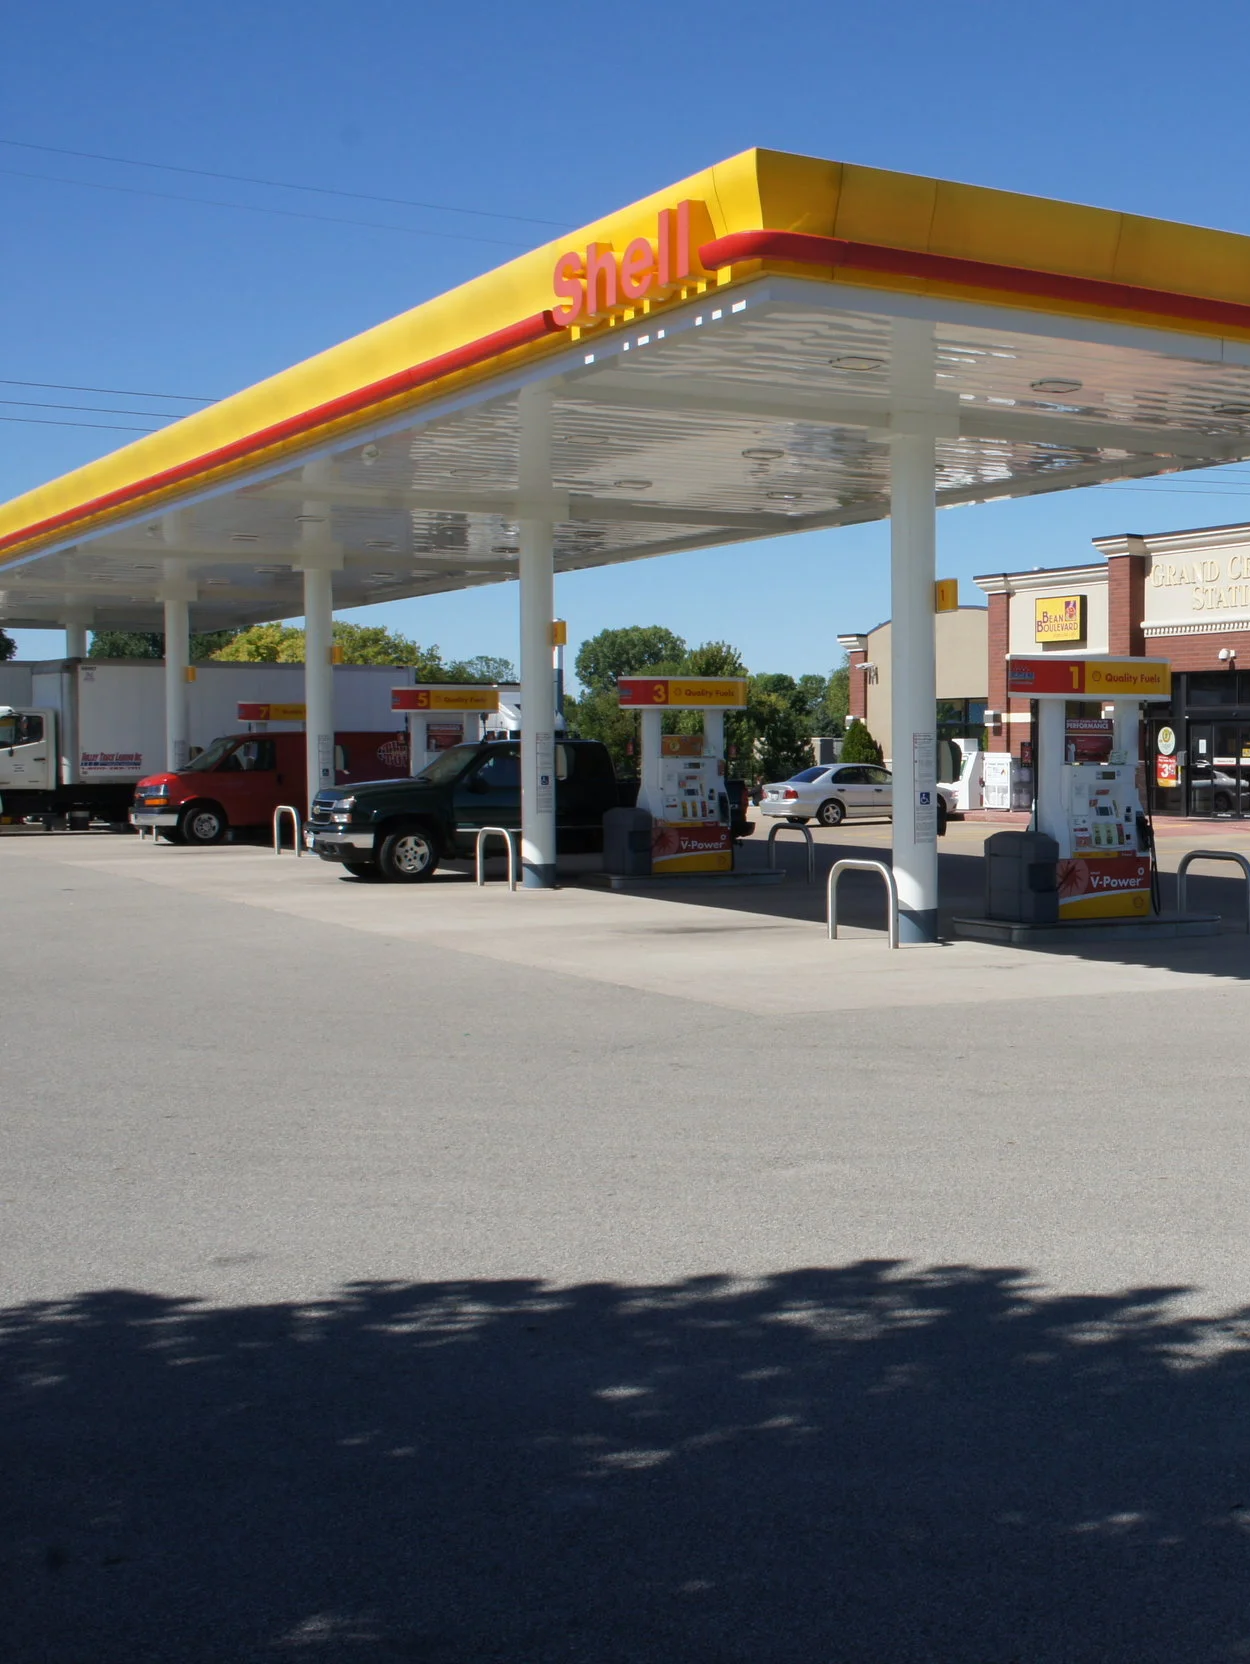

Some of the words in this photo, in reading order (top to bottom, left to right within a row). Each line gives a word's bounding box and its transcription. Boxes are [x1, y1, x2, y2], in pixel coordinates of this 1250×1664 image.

[1150, 560, 1220, 588] GRAND
[1042, 611, 1064, 624] BEAN
[1037, 620, 1079, 633] BOULEVARD
[1069, 666, 1079, 689] 1
[1105, 672, 1138, 685] Quality
[1140, 673, 1161, 684] Fuels
[417, 692, 427, 707] 5
[653, 684, 666, 703] 3
[684, 688, 713, 699] Quality
[715, 688, 735, 698] Fuels
[1066, 722, 1109, 730] PERFORMANCE
[680, 840, 725, 850] V-Power
[1090, 875, 1142, 889] V-Power
